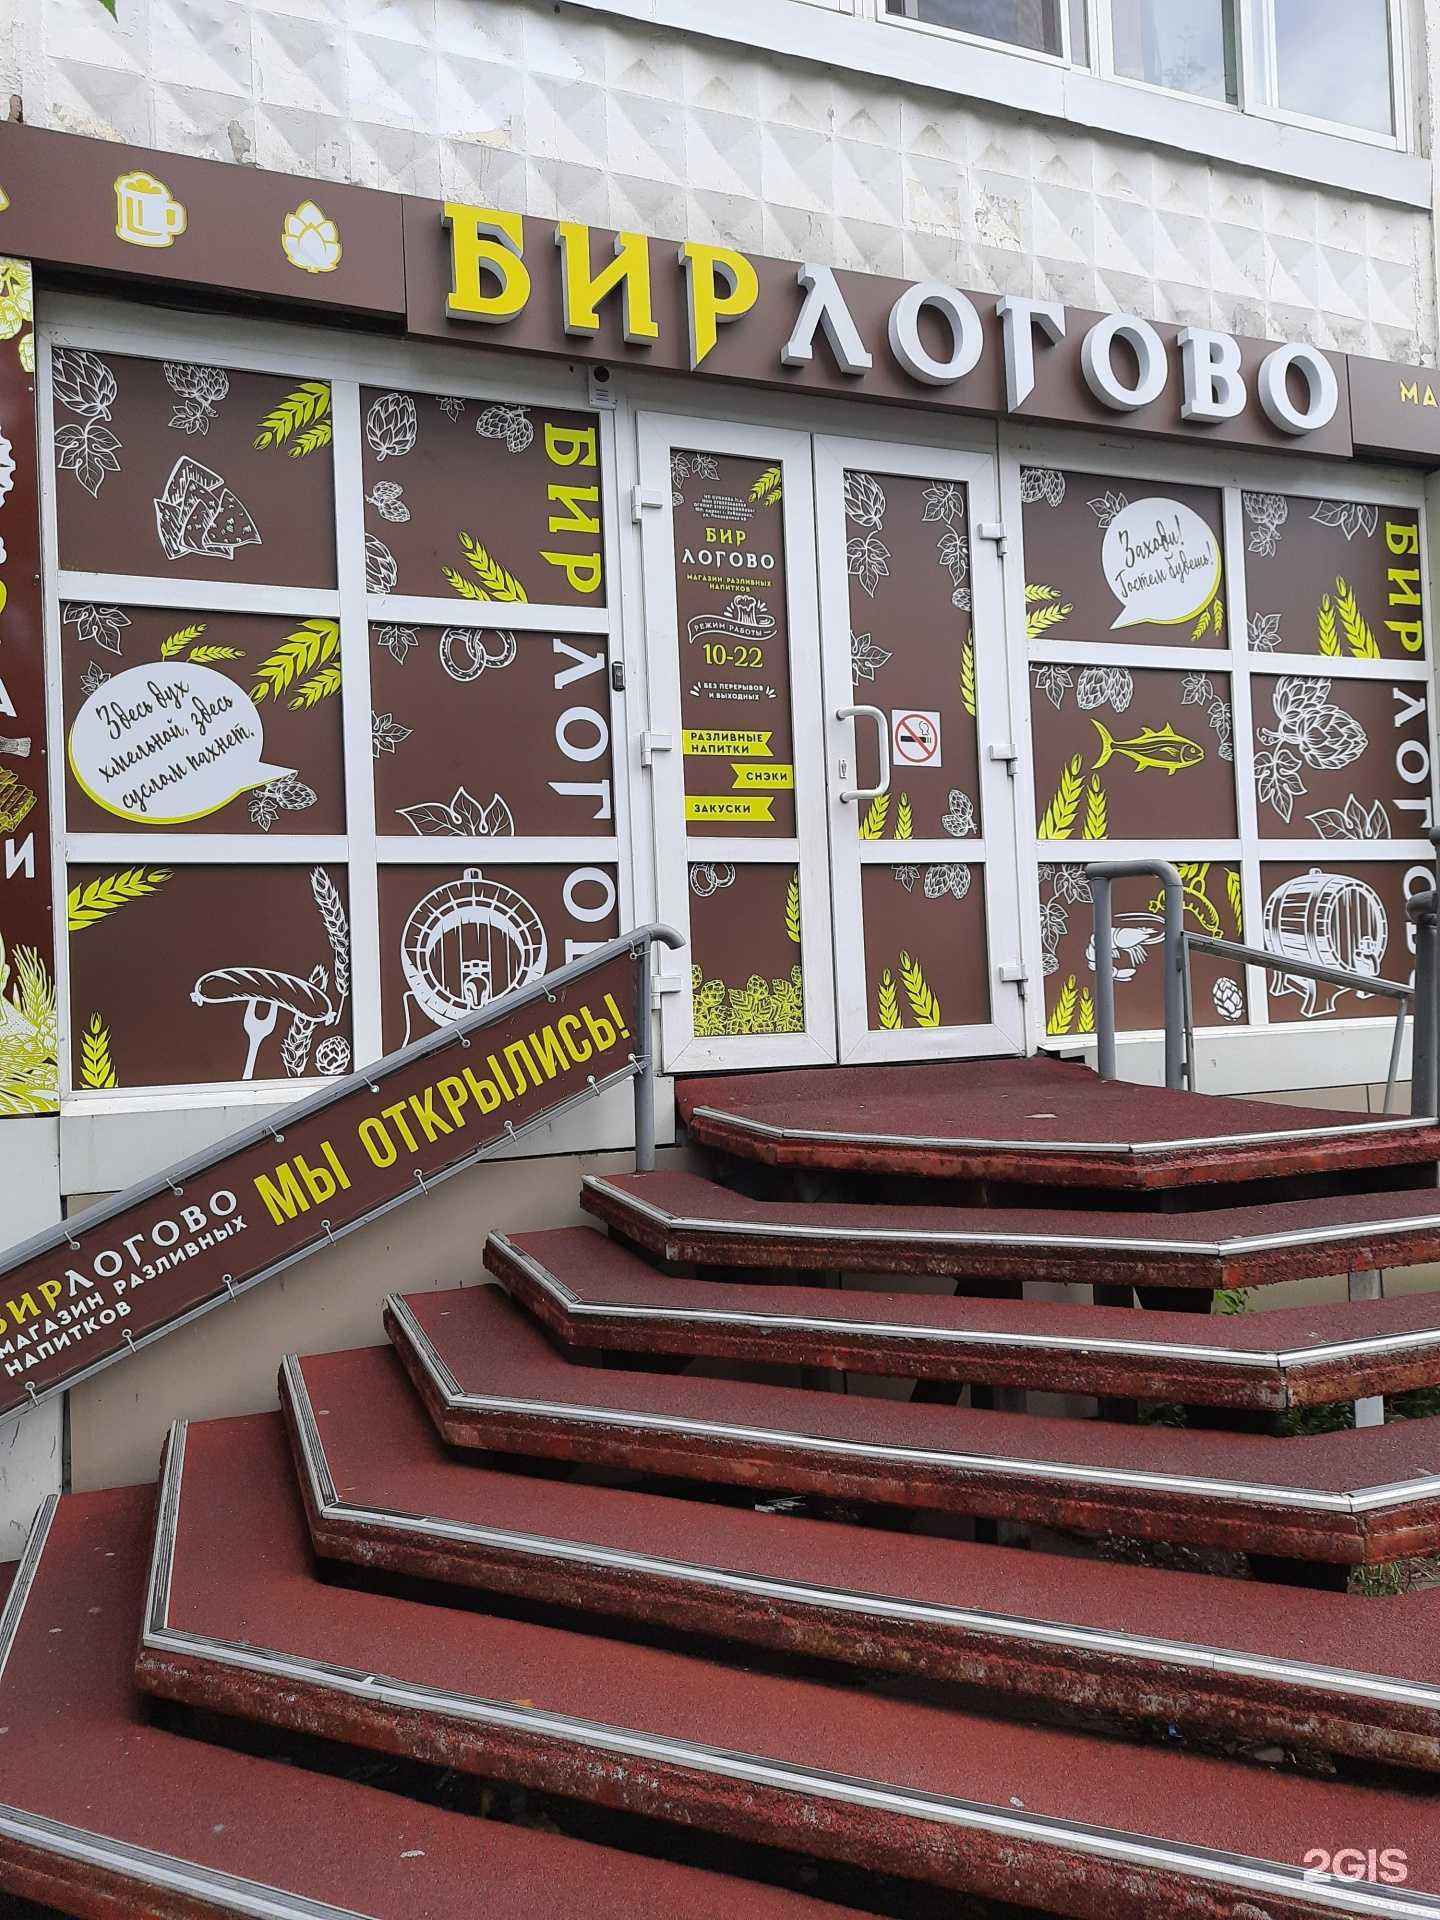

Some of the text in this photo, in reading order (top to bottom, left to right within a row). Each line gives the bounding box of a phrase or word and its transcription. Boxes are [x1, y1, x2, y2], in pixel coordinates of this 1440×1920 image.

[704, 526, 746, 548] БИР
[1118, 514, 1185, 568] Заходи!
[682, 548, 775, 570] ЛОГОВО
[1115, 540, 1214, 598] Гостем будешь!
[686, 573, 772, 587] МАГАЗИН РАЗЛИВНЫХ
[709, 582, 751, 593] НАПИТКОВ
[694, 621, 762, 636] РЕЖИМ РАБОТЫ
[703, 643, 763, 668] 10-22
[716, 692, 760, 700] ВЫХОДНЫХ
[719, 683, 764, 691] ПЕРЕРЫВОВ
[95, 680, 190, 740] Здесь дух
[98, 696, 233, 784] хмельной, здесь
[690, 732, 764, 743] РАЗЛИВНЫЕ
[691, 744, 750, 754] НАПИТКИ
[122, 723, 255, 813] суслом пахнет.
[746, 771, 788, 781] СНЭКИ
[694, 804, 751, 814] ЗАКУСКИ
[253, 993, 631, 1226] МЫ ОТКРЫЛИСЬ!
[0, 1215, 248, 1360] МАГАЗИН РАЗЛИВНЫХ
[4, 1301, 131, 1377] НАПИТКОВ
